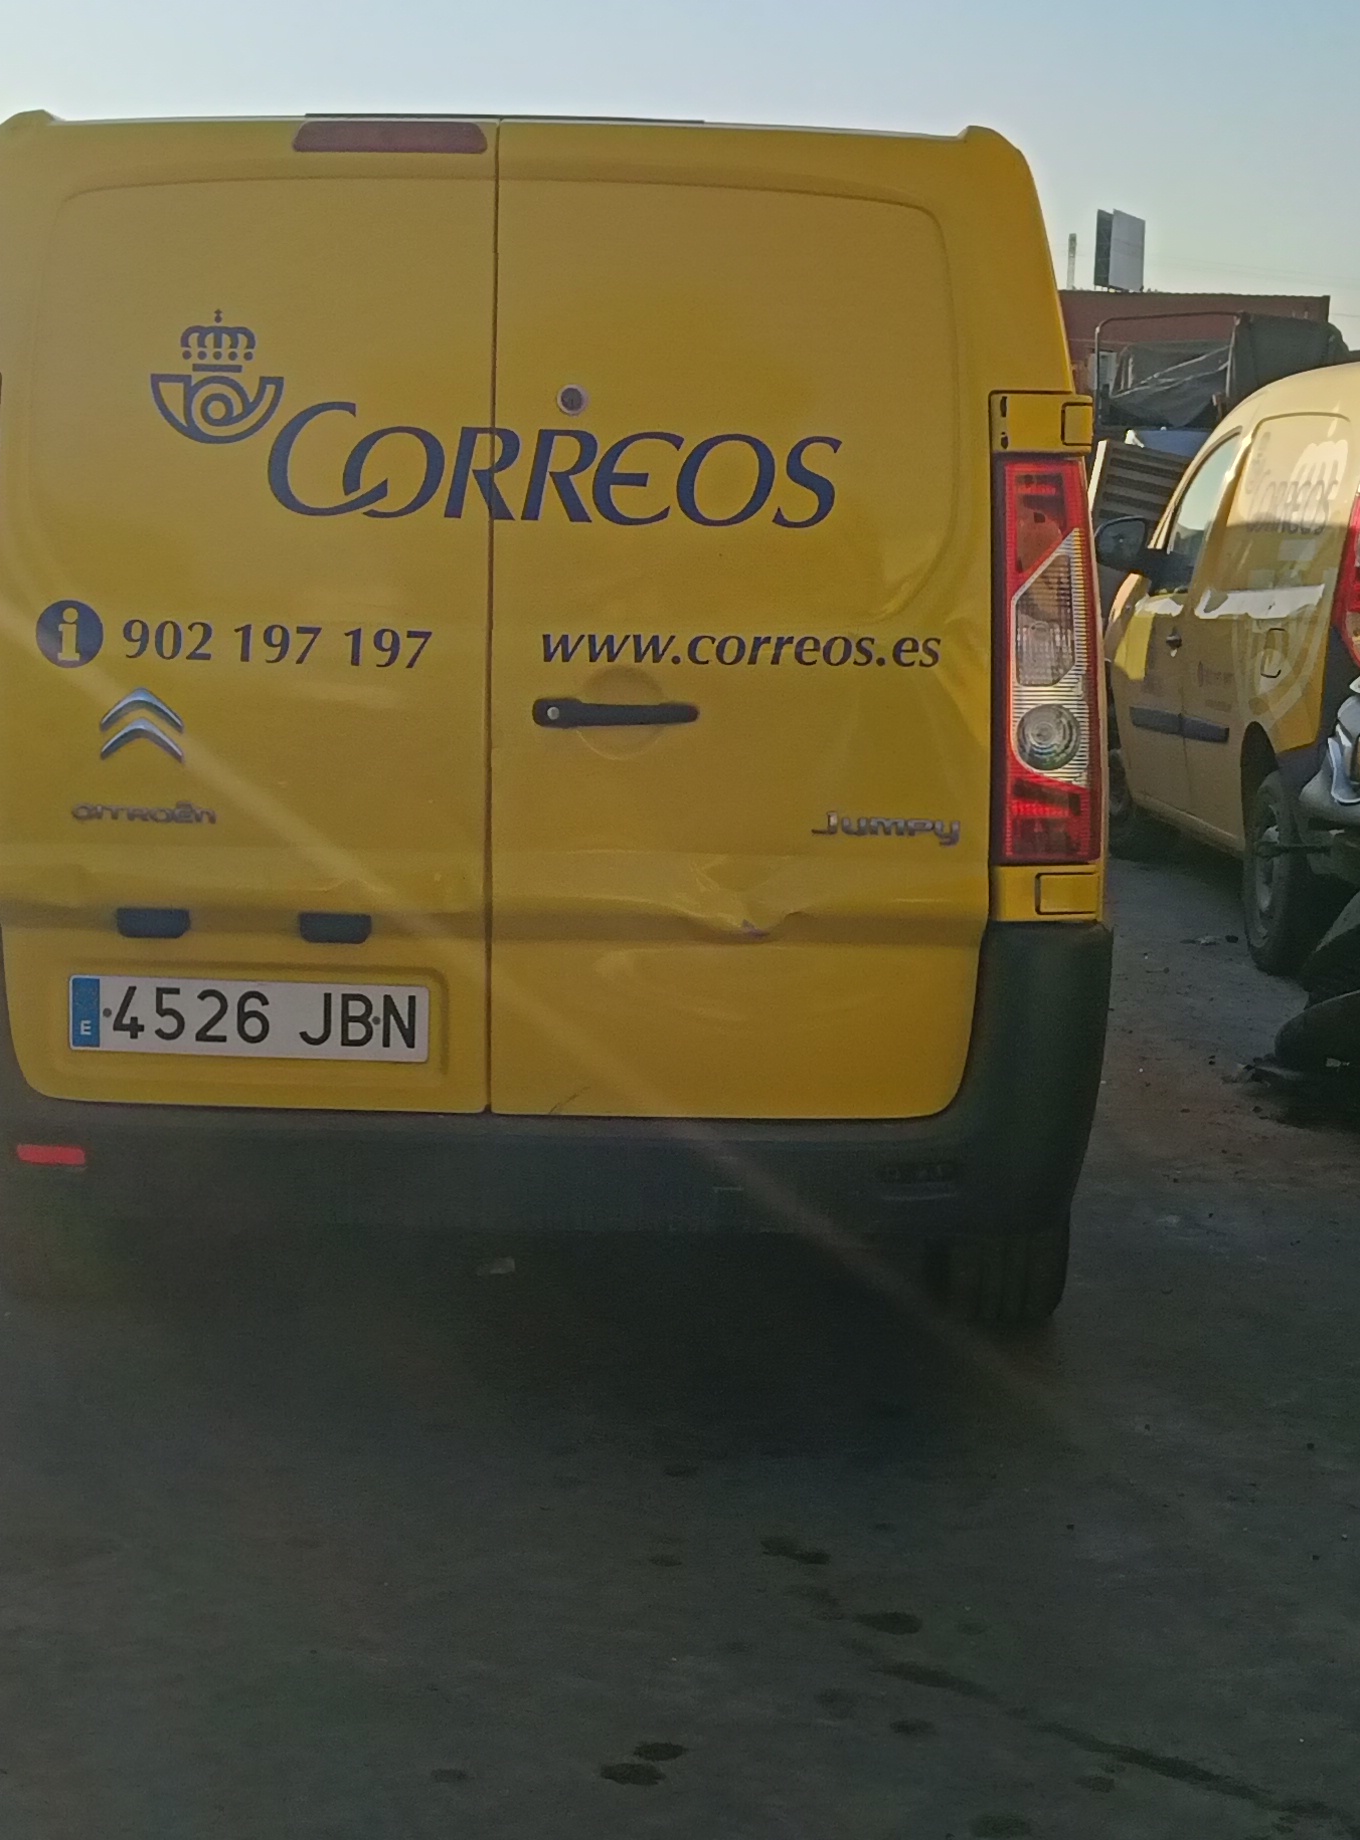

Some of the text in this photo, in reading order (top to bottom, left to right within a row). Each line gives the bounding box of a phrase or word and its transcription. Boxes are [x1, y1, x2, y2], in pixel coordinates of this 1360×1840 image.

[267, 401, 843, 529] CORREOS
[122, 619, 213, 661] 902
[234, 623, 322, 664] 197
[344, 627, 433, 669] 197
[542, 633, 941, 668] www.correos.es
[80, 985, 417, 1049] E 4526 JBN
